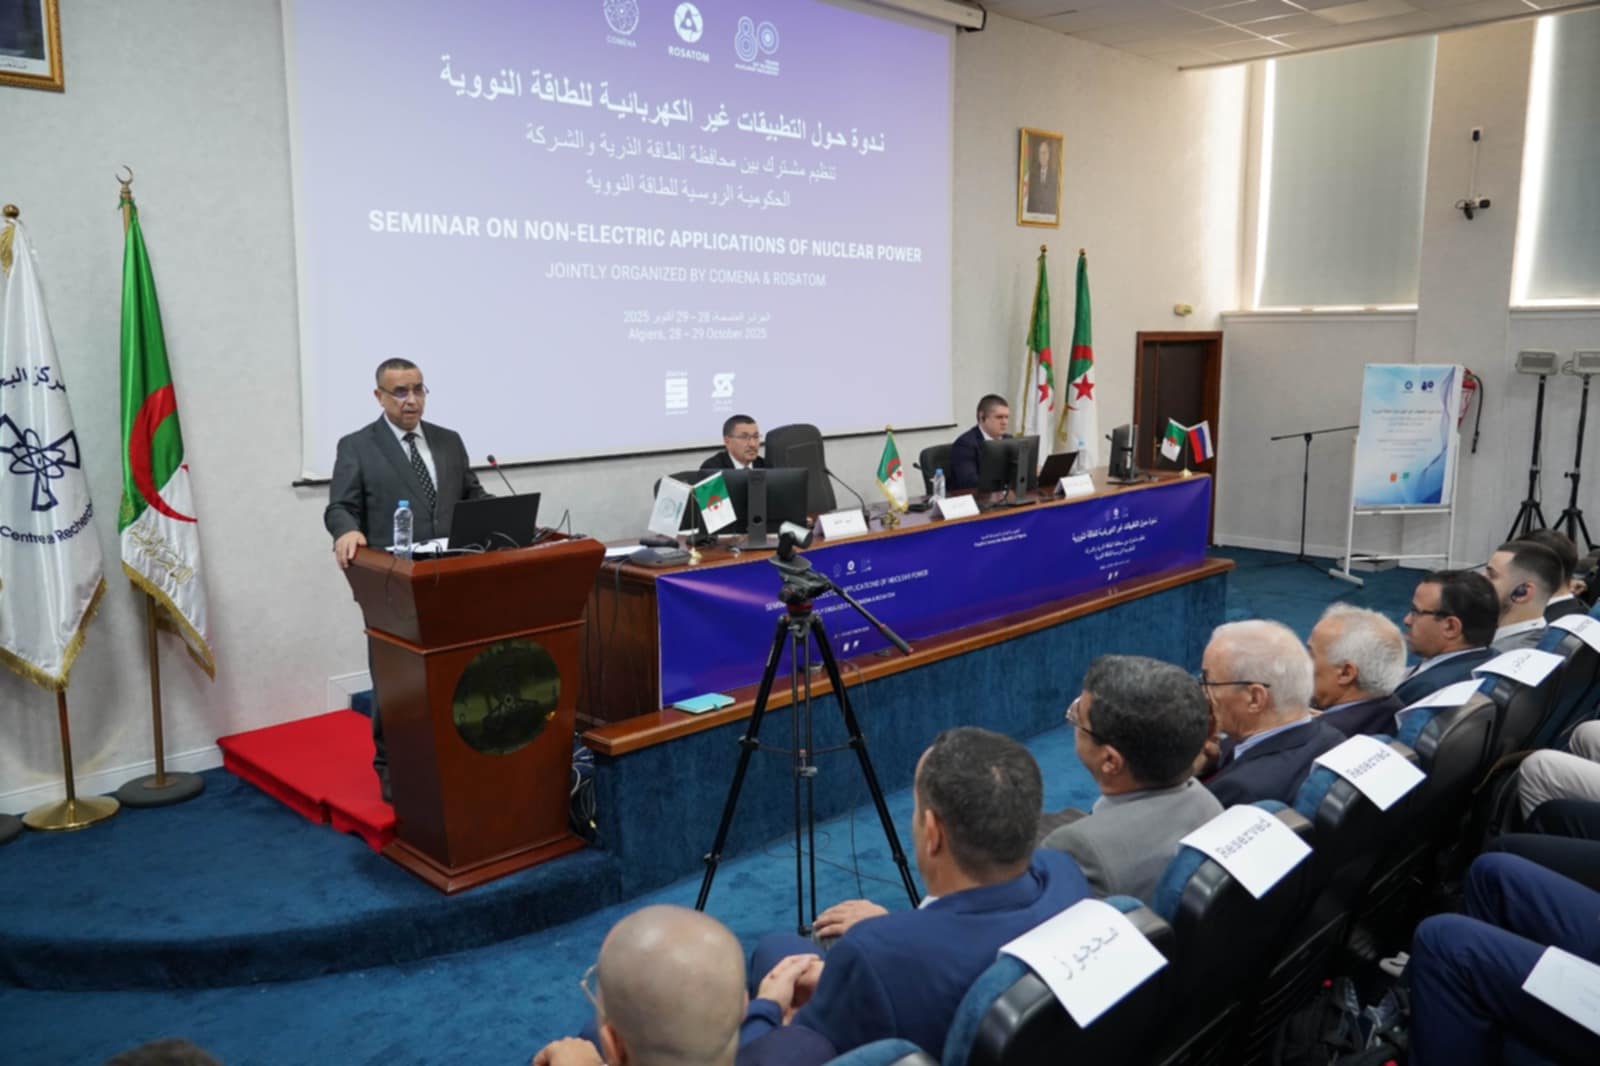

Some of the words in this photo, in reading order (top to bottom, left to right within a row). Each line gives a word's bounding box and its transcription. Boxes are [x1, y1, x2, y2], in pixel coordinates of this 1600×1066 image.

[668, 46, 710, 63] ROSATOM
[439, 54, 522, 100] النووية
[530, 69, 593, 107] للطاقة
[599, 80, 693, 127] الكهربائية
[700, 104, 730, 133] غير
[736, 111, 806, 141] التطبيقات
[525, 122, 595, 156] والشركة
[599, 134, 641, 160] الذرية
[811, 121, 847, 150] حول
[850, 128, 885, 155] ندوة
[647, 140, 685, 161] الطاقة
[689, 144, 737, 168] محافظة
[740, 158, 759, 175] بين
[762, 156, 806, 178] مشترك
[808, 162, 837, 184] تنظيم
[585, 169, 635, 196] النووية
[638, 174, 678, 196] للطاقة
[681, 179, 735, 206] الروسية
[738, 186, 791, 209] الحكومية
[368, 209, 480, 237] SEMINAR
[486, 217, 518, 239] ON
[524, 219, 666, 247] NON-ELECTRIC
[670, 229, 786, 255] APPLICATIONS
[789, 238, 809, 256] OF
[812, 240, 875, 261] NUCLEAR
[877, 246, 922, 263] POWER
[545, 262, 607, 280] JOINTLY
[611, 264, 687, 282] ORGANIZED
[689, 267, 706, 282] BY
[709, 268, 761, 285] COMENA
[762, 271, 770, 285] &
[773, 271, 827, 287] ROSATOM
[0, 525, 46, 545] Centre
[1346, 749, 1391, 779] Reserved
[1215, 817, 1272, 859] Reserved
